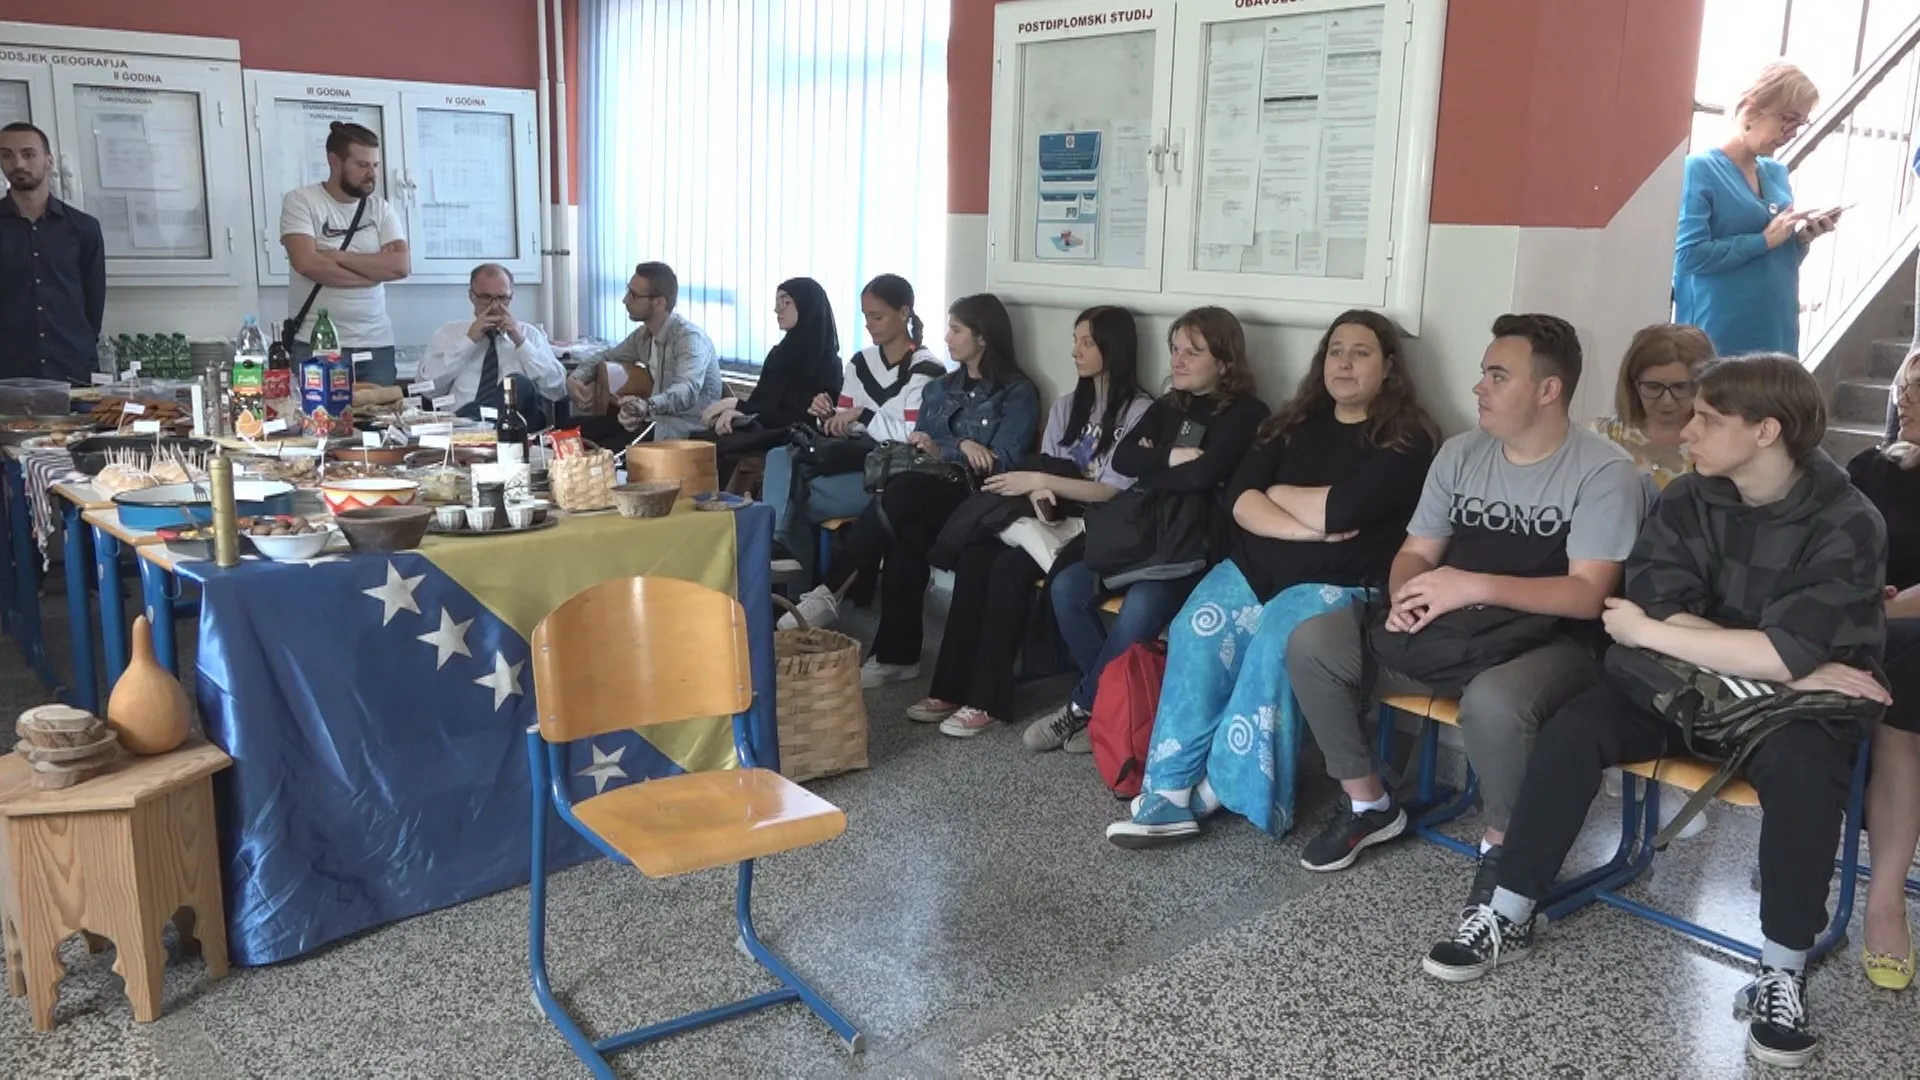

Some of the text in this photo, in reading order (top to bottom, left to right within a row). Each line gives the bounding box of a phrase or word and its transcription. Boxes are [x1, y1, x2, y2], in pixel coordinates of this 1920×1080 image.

[1018, 8, 1154, 35] POSTDIPLOMSKI STUDIJ
[0, 51, 129, 69] ODSJEK GEOGRAFIJA
[113, 71, 162, 84] II GODINA
[306, 86, 352, 98] III GODINA
[445, 96, 487, 107] IV GODINA
[1449, 492, 1564, 537] ICONO
